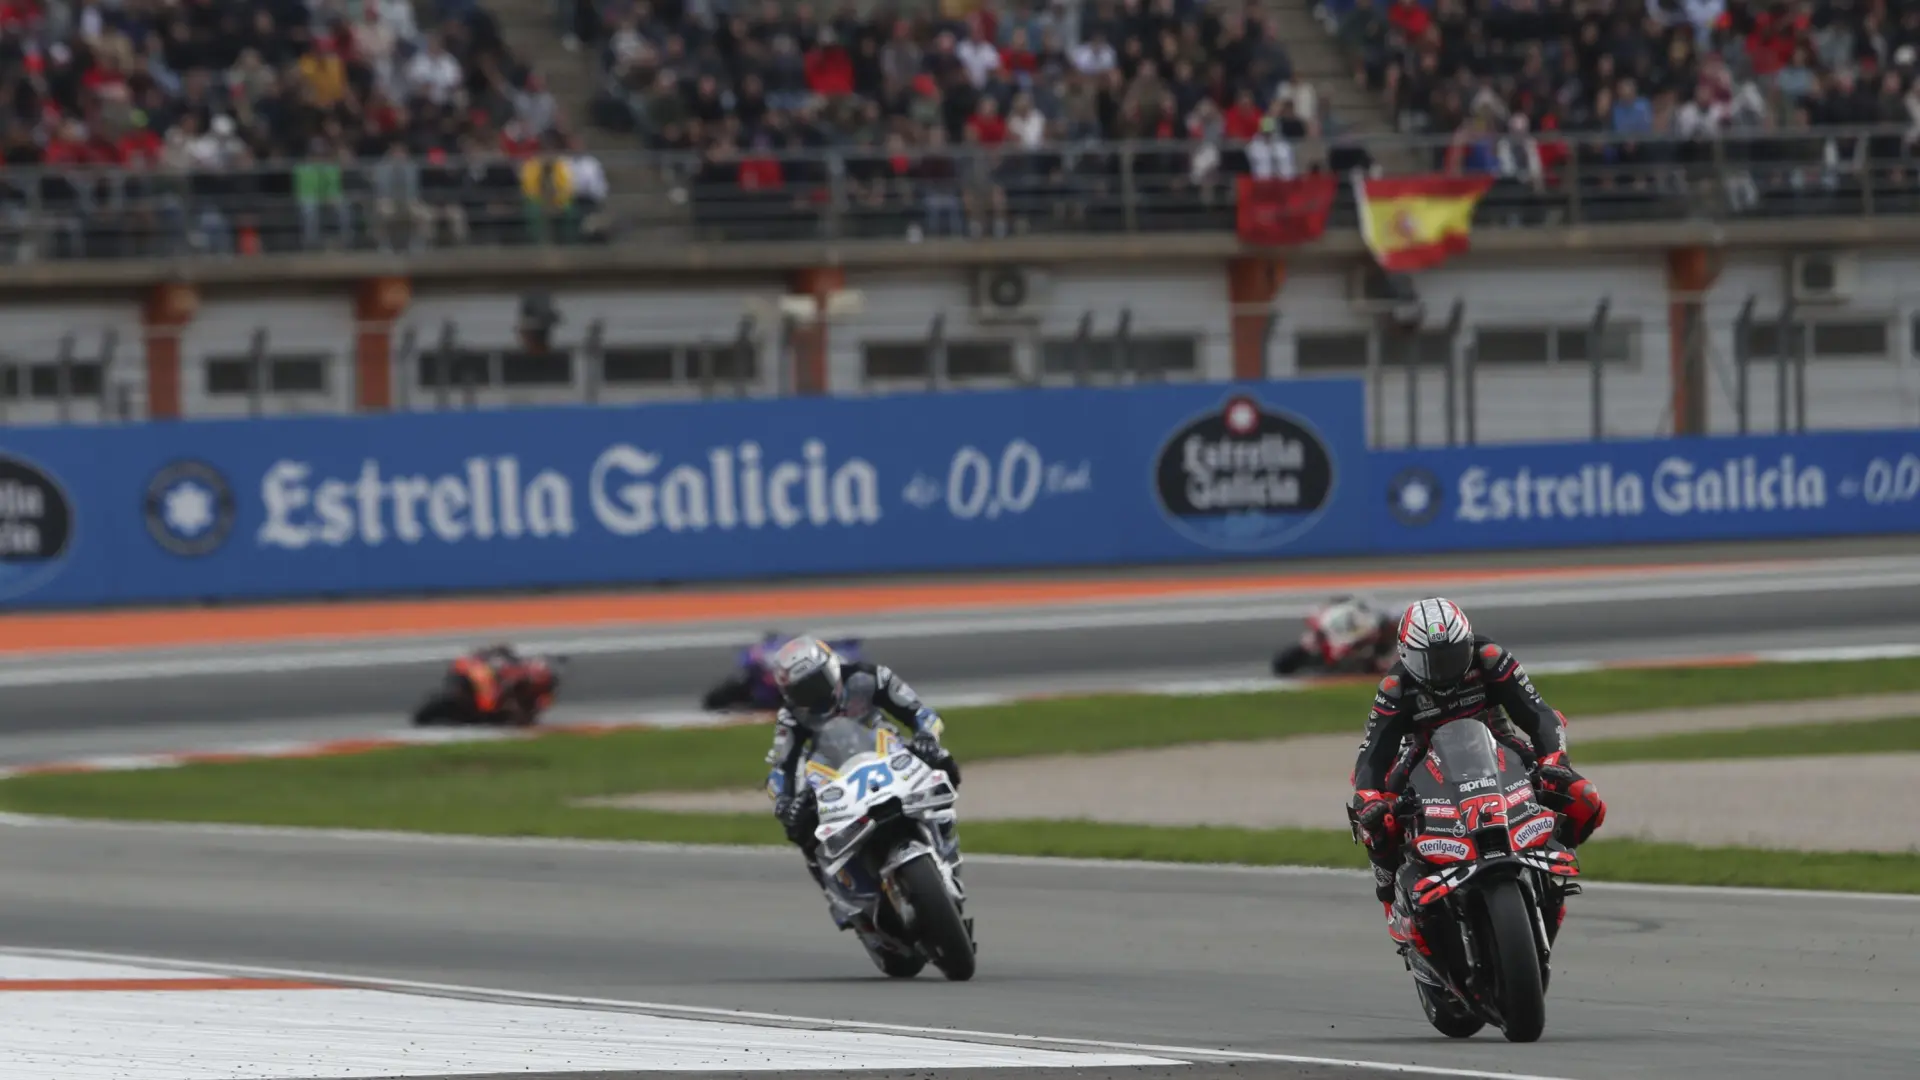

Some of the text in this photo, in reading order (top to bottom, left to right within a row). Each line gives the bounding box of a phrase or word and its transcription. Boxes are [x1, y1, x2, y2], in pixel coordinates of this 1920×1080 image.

[1182, 433, 1304, 472] Estrella
[258, 456, 577, 548] Estrella
[588, 440, 881, 536] Galicia
[1456, 462, 1644, 522] Estrella
[1652, 453, 1826, 516] Galicia
[1459, 777, 1497, 792] aprilia
[1505, 778, 1531, 793] TARGA
[1506, 787, 1531, 803] BS
[1425, 806, 1456, 815] BS
[1459, 793, 1508, 833] 72
[1515, 818, 1553, 845] sterilgarda
[1420, 839, 1466, 856] sterilgarda
